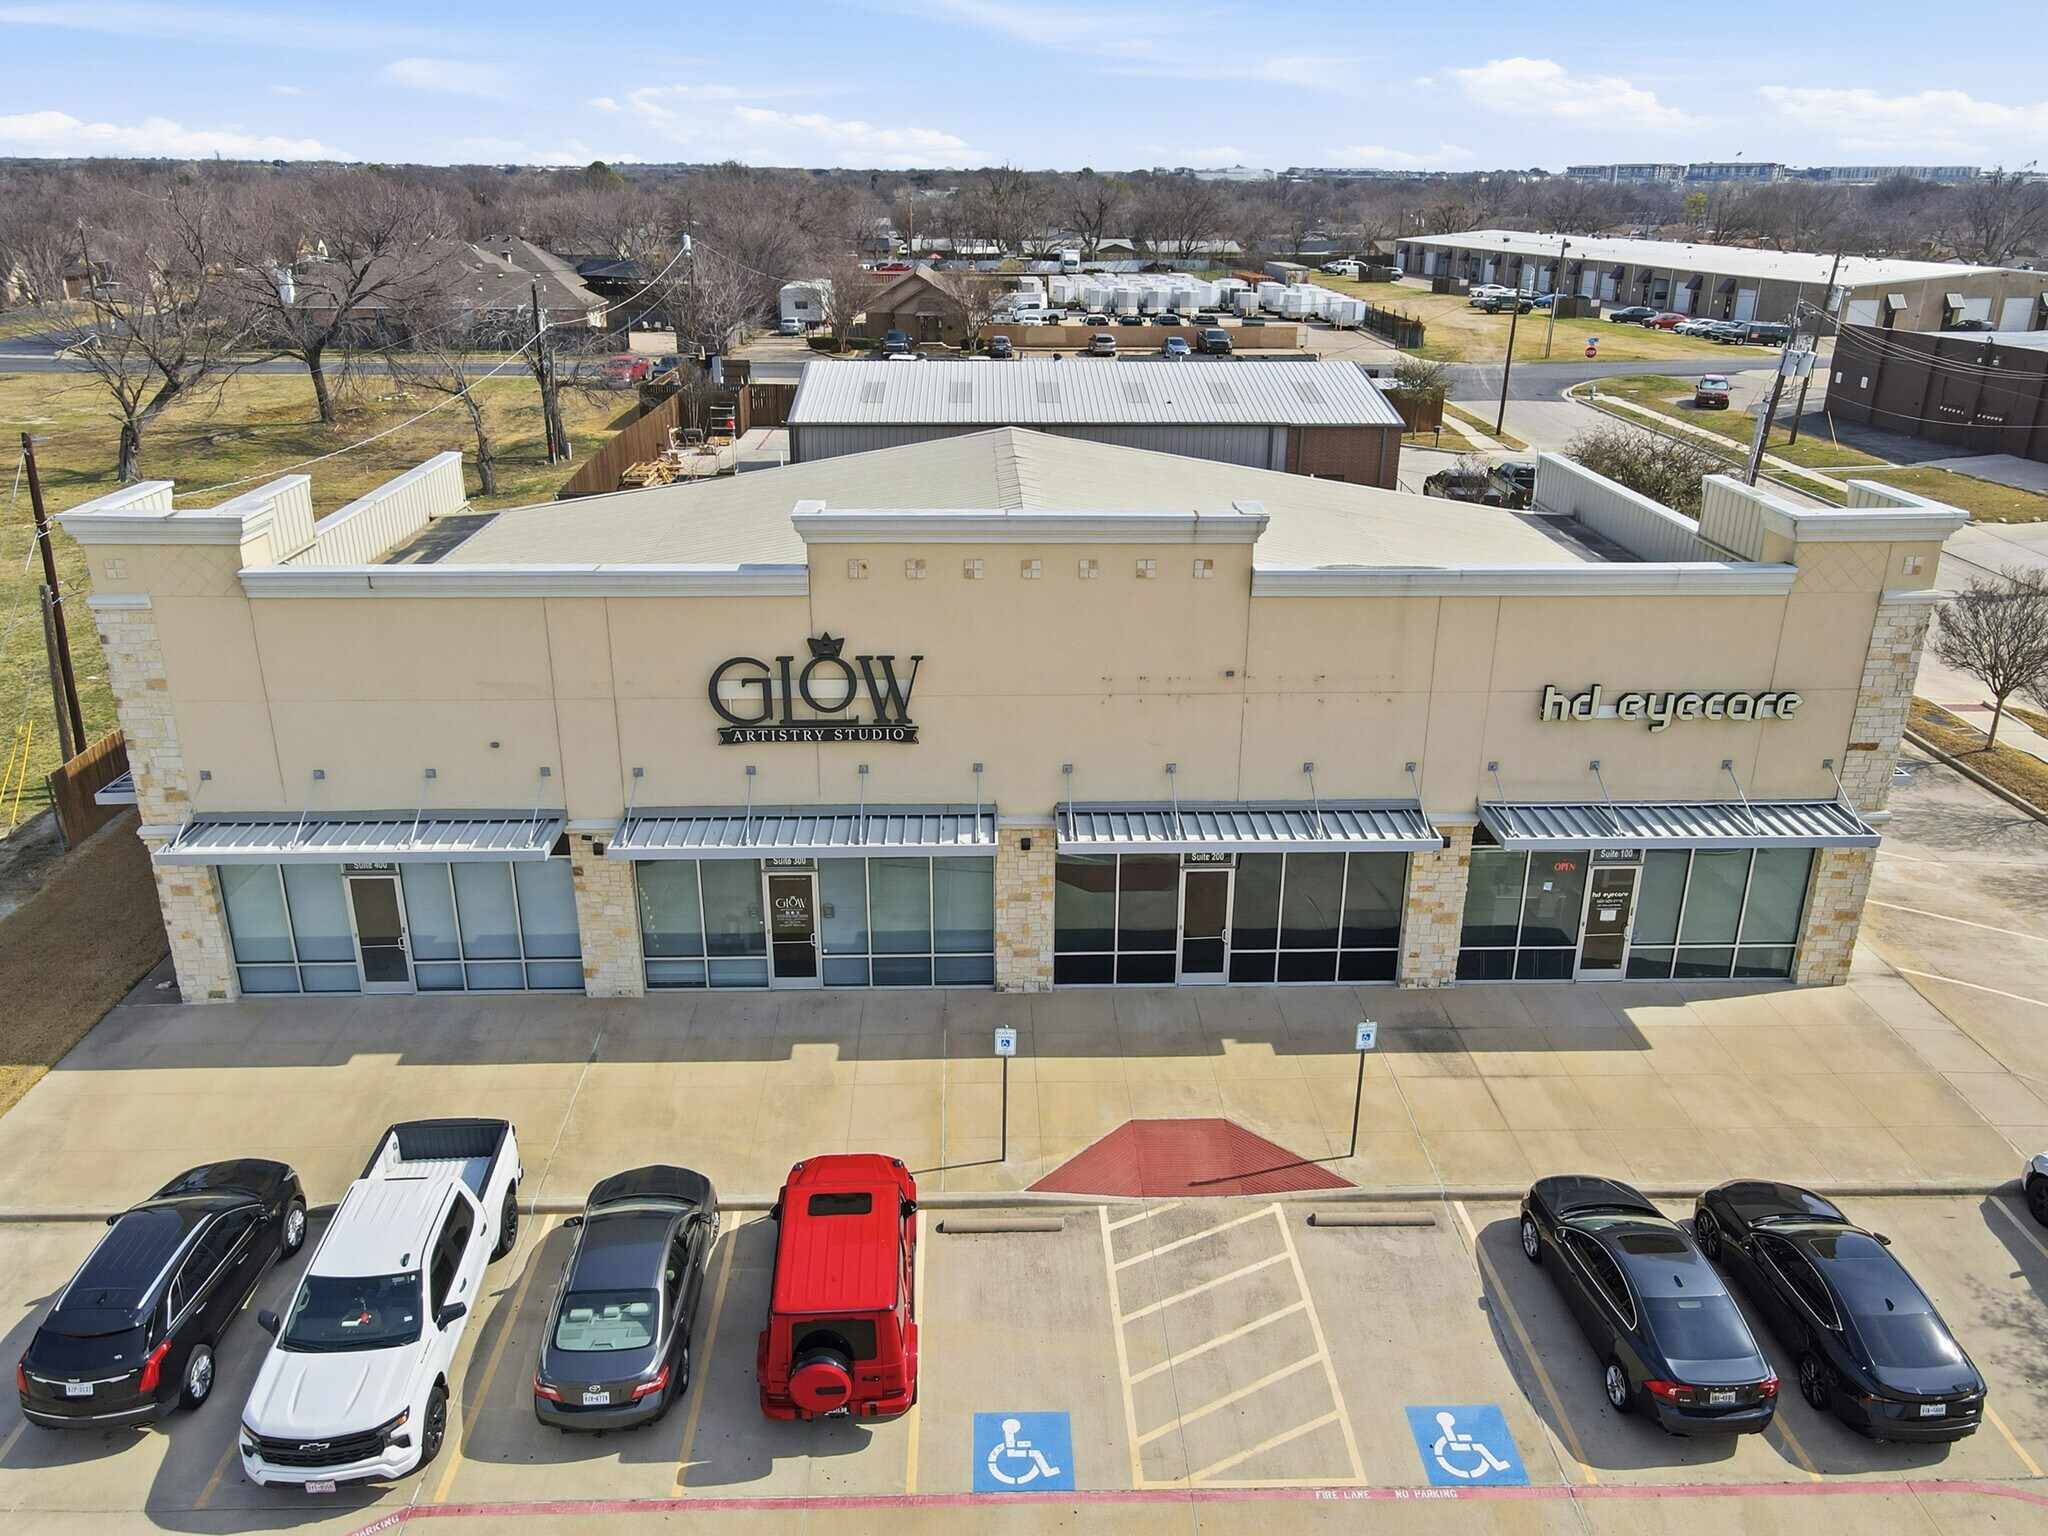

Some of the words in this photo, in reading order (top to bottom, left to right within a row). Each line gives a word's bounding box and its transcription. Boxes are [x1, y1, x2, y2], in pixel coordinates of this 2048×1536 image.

[708, 655, 925, 726] GLOW
[1540, 683, 1602, 722] hd
[1615, 691, 1804, 733] eyecare
[732, 729, 825, 742] ARTISTRY
[833, 728, 906, 741] STUDIO
[1191, 852, 1211, 861] Suite
[1211, 852, 1225, 861] 200
[1600, 849, 1619, 858] Suite
[1620, 849, 1633, 858] 100
[1554, 862, 1576, 871] OPEN
[1315, 1489, 1339, 1500] FIRE
[1343, 1489, 1371, 1500] LANE
[1394, 1489, 1409, 1499] NO
[1414, 1489, 1458, 1499] PARKING
